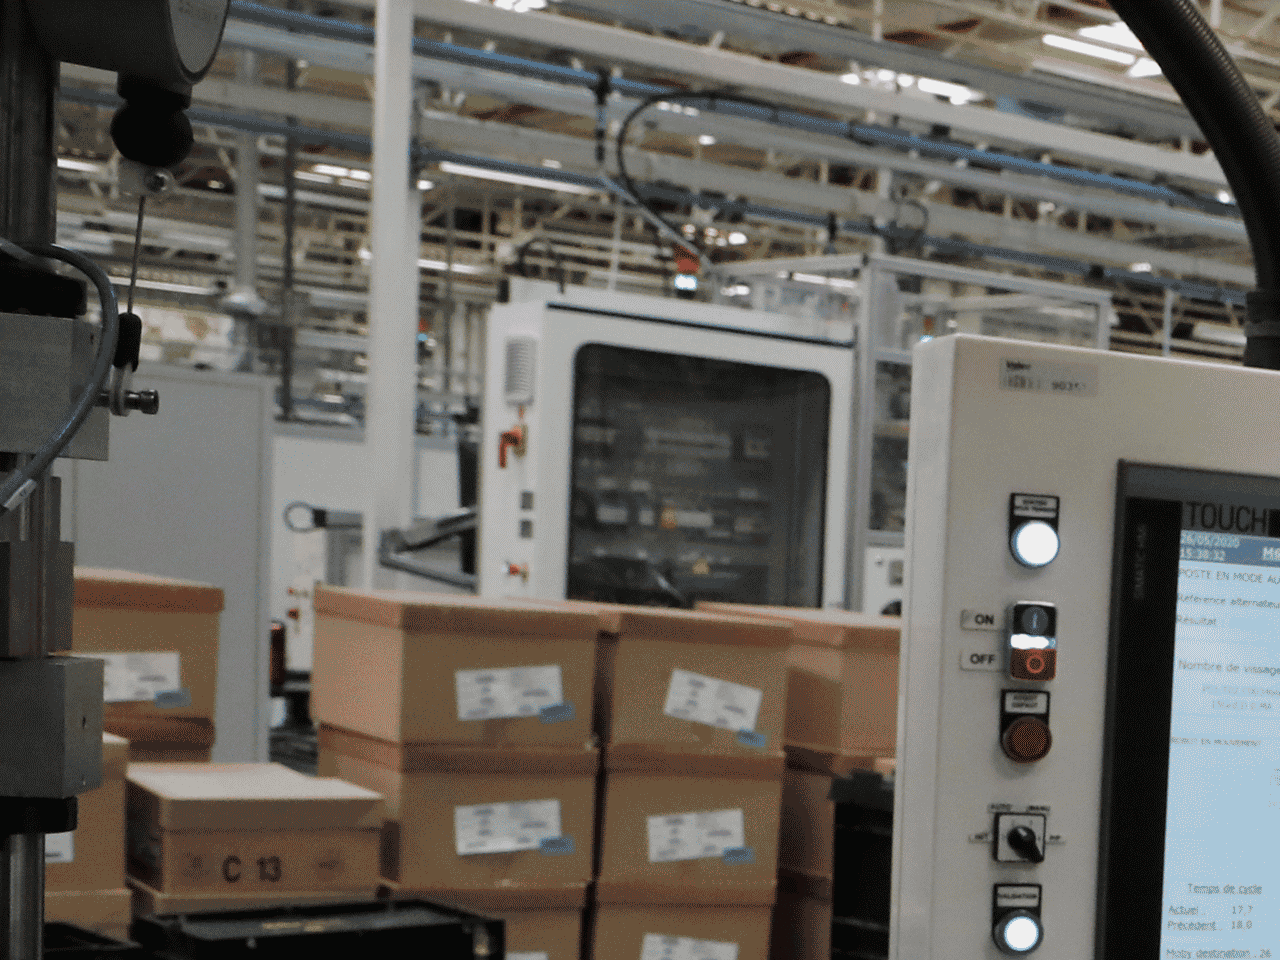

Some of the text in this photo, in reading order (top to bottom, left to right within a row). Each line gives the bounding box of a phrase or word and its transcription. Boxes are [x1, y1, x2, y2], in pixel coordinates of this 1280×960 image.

[1187, 501, 1268, 533] TOUCH
[1179, 568, 1212, 580] POSTE
[1216, 570, 1230, 581] EN
[1233, 571, 1263, 583] MODE
[975, 613, 995, 626] ON
[970, 653, 996, 665] OFF
[1179, 660, 1222, 671] Nombre
[1226, 663, 1239, 673] de
[222, 855, 282, 883] C 13
[1188, 883, 1262, 895] Temps de cycle
